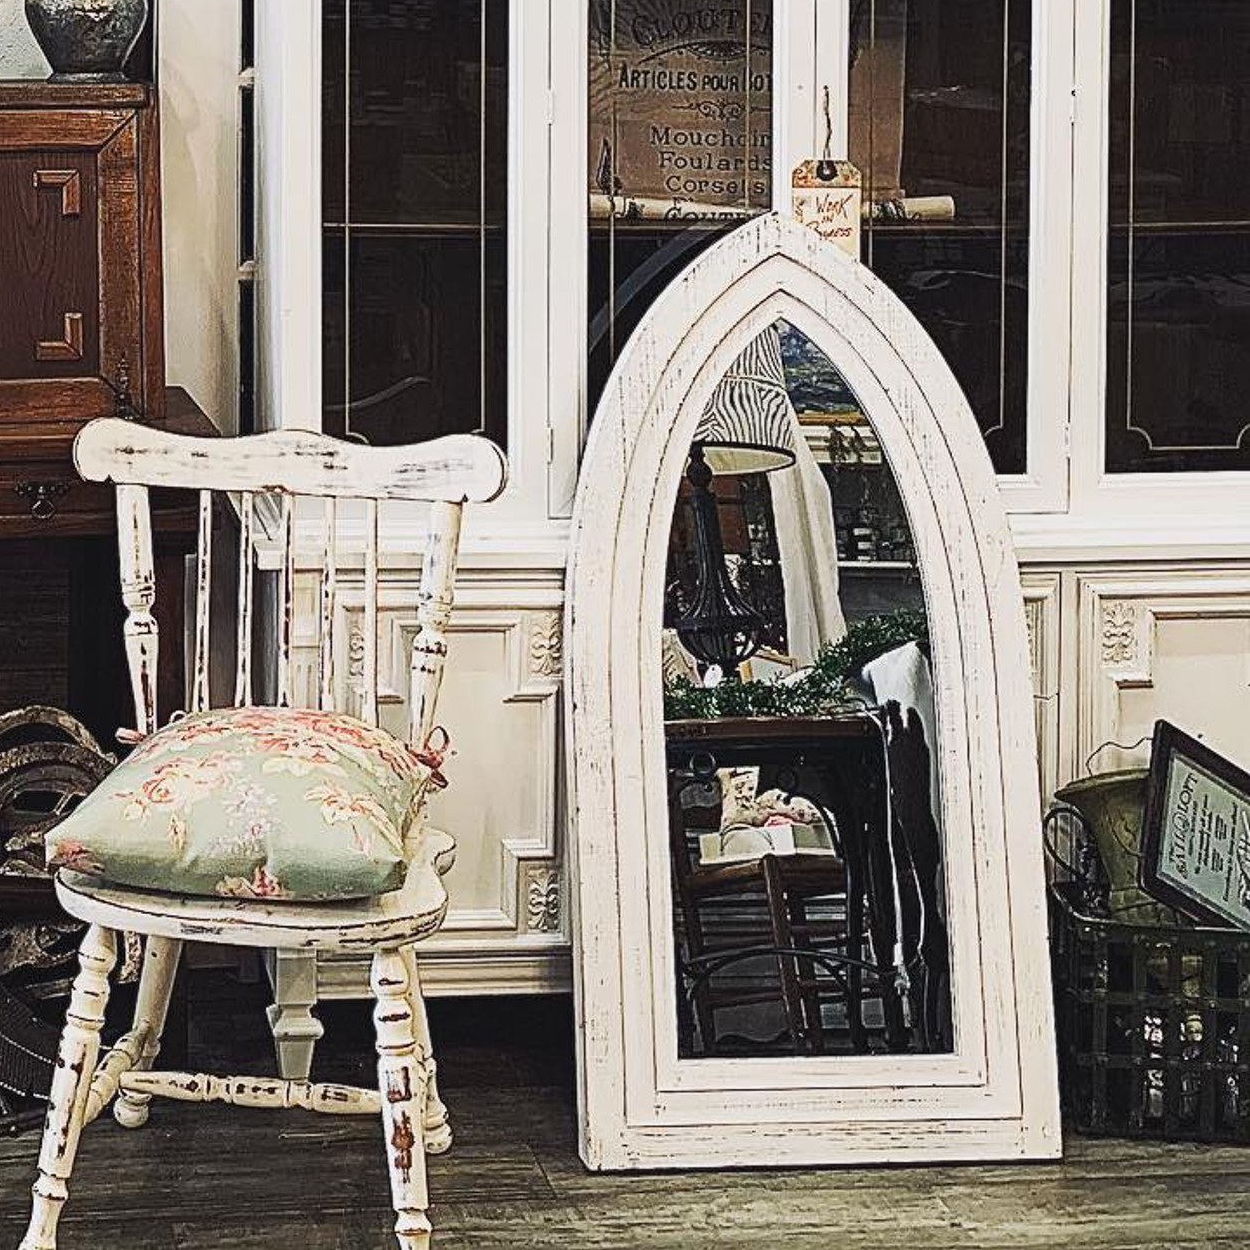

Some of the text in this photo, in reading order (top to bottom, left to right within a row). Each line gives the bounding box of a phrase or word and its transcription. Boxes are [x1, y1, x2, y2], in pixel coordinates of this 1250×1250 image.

[618, 64, 697, 91] ARTICLES
[701, 75, 740, 91] POUR
[659, 151, 771, 172] Foulards
